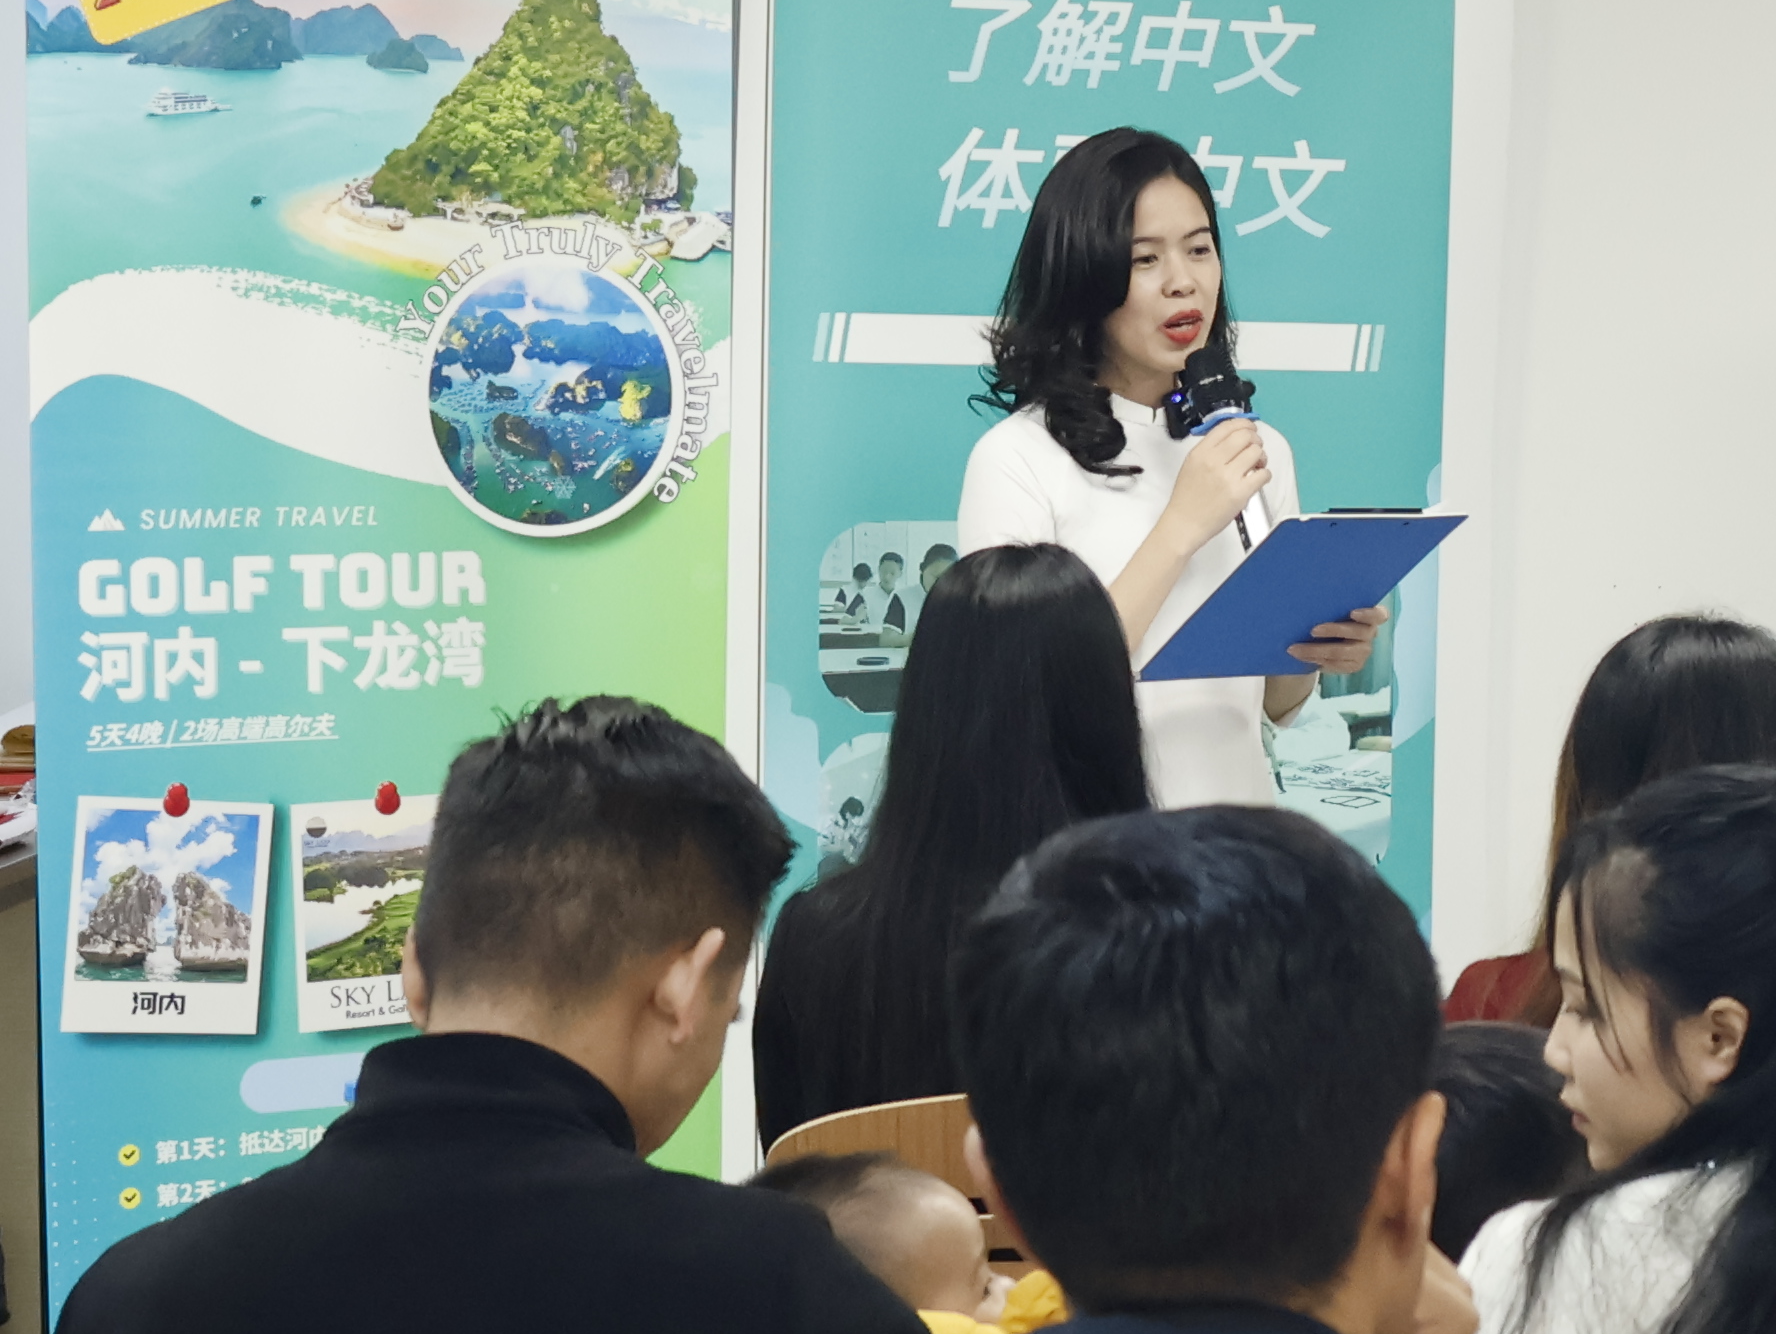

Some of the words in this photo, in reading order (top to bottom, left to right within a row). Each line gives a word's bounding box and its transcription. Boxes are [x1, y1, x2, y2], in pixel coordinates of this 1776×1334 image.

[396, 244, 486, 340] Your
[491, 220, 622, 272] Truly
[627, 247, 719, 504] Travelmate
[139, 507, 262, 531] SUMMER
[275, 505, 379, 528] TRAVEL
[77, 554, 274, 617] GOLF
[289, 550, 488, 611] TOUR
[77, 625, 219, 702] 河内
[281, 615, 488, 695] 下龙湾
[131, 990, 187, 1017] 河内
[330, 984, 376, 1009] SKY
[345, 1008, 376, 1019] Resort
[378, 1006, 386, 1016] &
